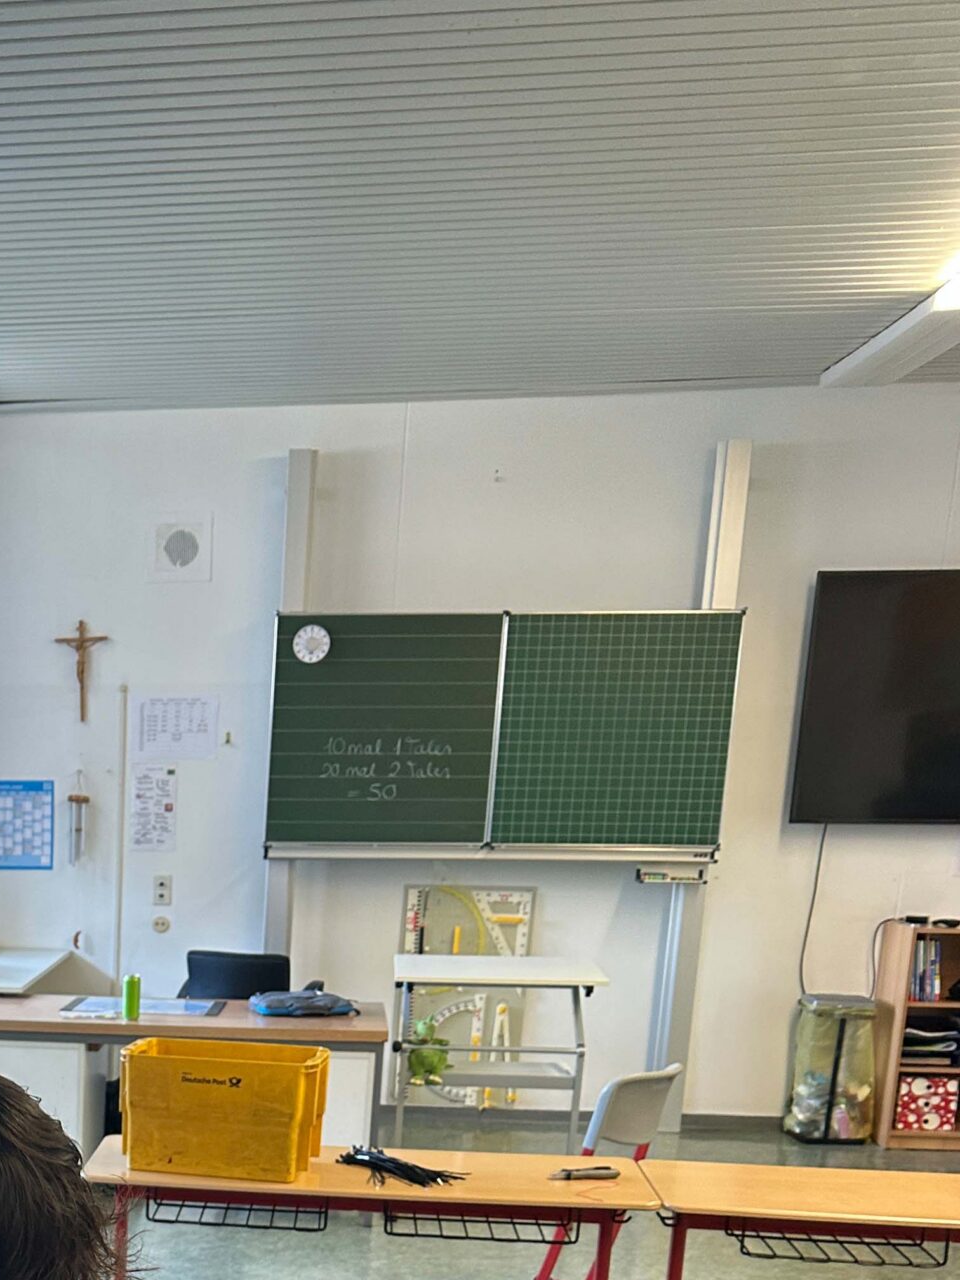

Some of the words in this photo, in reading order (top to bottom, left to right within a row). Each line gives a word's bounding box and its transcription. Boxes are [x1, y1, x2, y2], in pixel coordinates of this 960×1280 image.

[388, 761, 401, 778] 2
[366, 783, 397, 801] 50
[181, 1076, 211, 1084] Deutsche
[212, 1078, 227, 1086] Post
